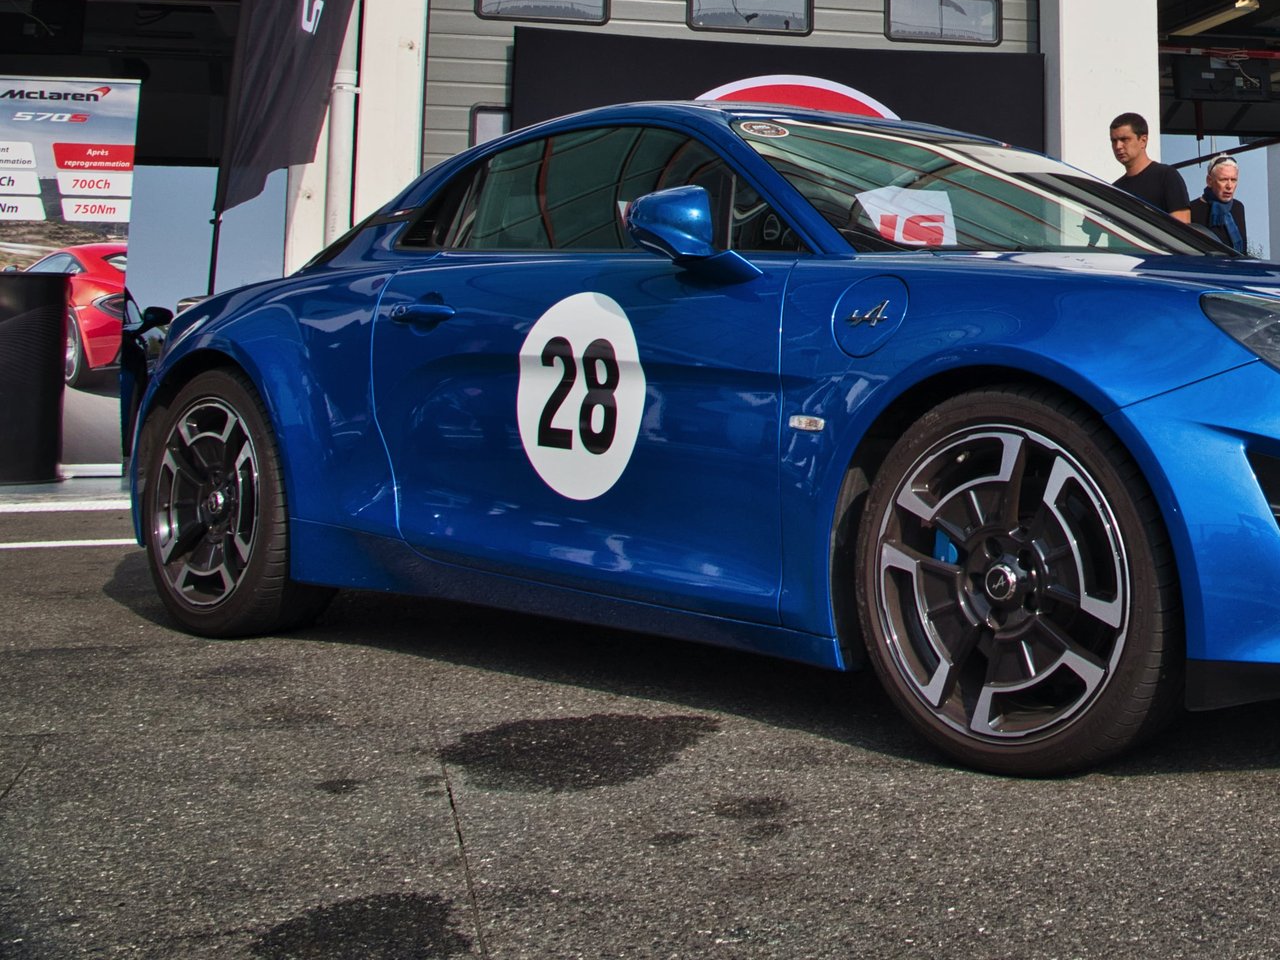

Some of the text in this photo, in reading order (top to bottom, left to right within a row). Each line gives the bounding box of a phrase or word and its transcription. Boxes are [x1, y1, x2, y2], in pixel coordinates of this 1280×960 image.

[0, 89, 99, 101] McLaren
[13, 112, 90, 123] 570S
[64, 160, 130, 168] reprogrammation
[72, 179, 111, 189] 700Ch
[74, 205, 116, 215] 750Nm
[537, 336, 620, 455] 28
